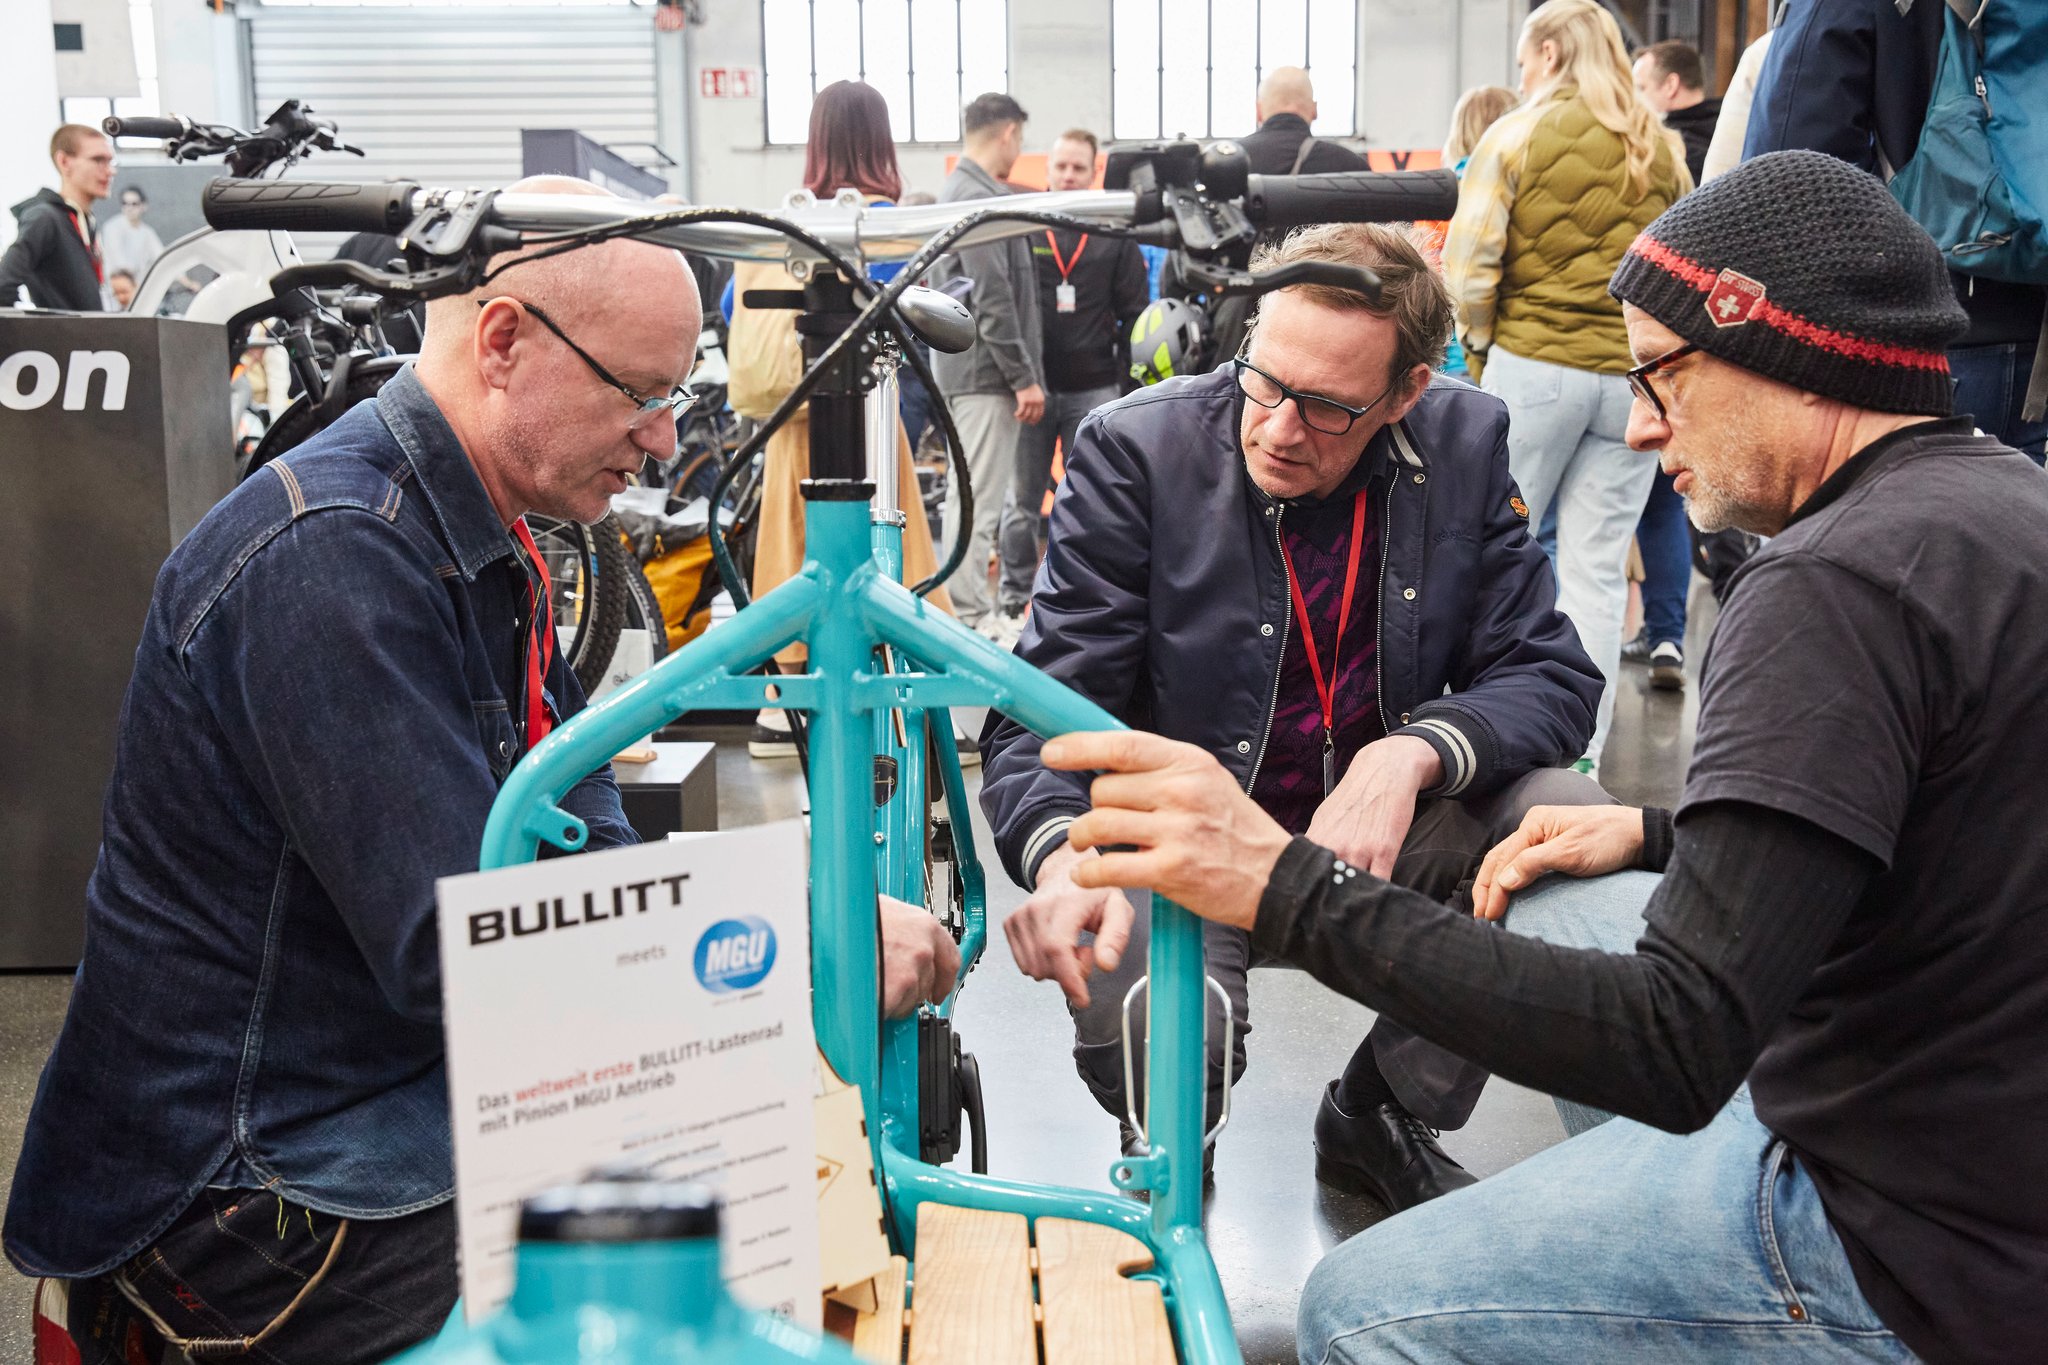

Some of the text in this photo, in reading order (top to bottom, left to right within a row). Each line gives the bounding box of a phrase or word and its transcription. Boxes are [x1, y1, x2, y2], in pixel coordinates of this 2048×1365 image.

[1720, 272, 1763, 297] DT SWISS
[0, 350, 130, 411] on
[468, 873, 691, 946] BULLITT
[616, 945, 667, 968] meets
[705, 929, 768, 976] MGU
[478, 1021, 784, 1113] Das weltweit erste BULLITT-Lastenrad
[479, 1071, 675, 1135] mit Pinion MGU Antrieb
